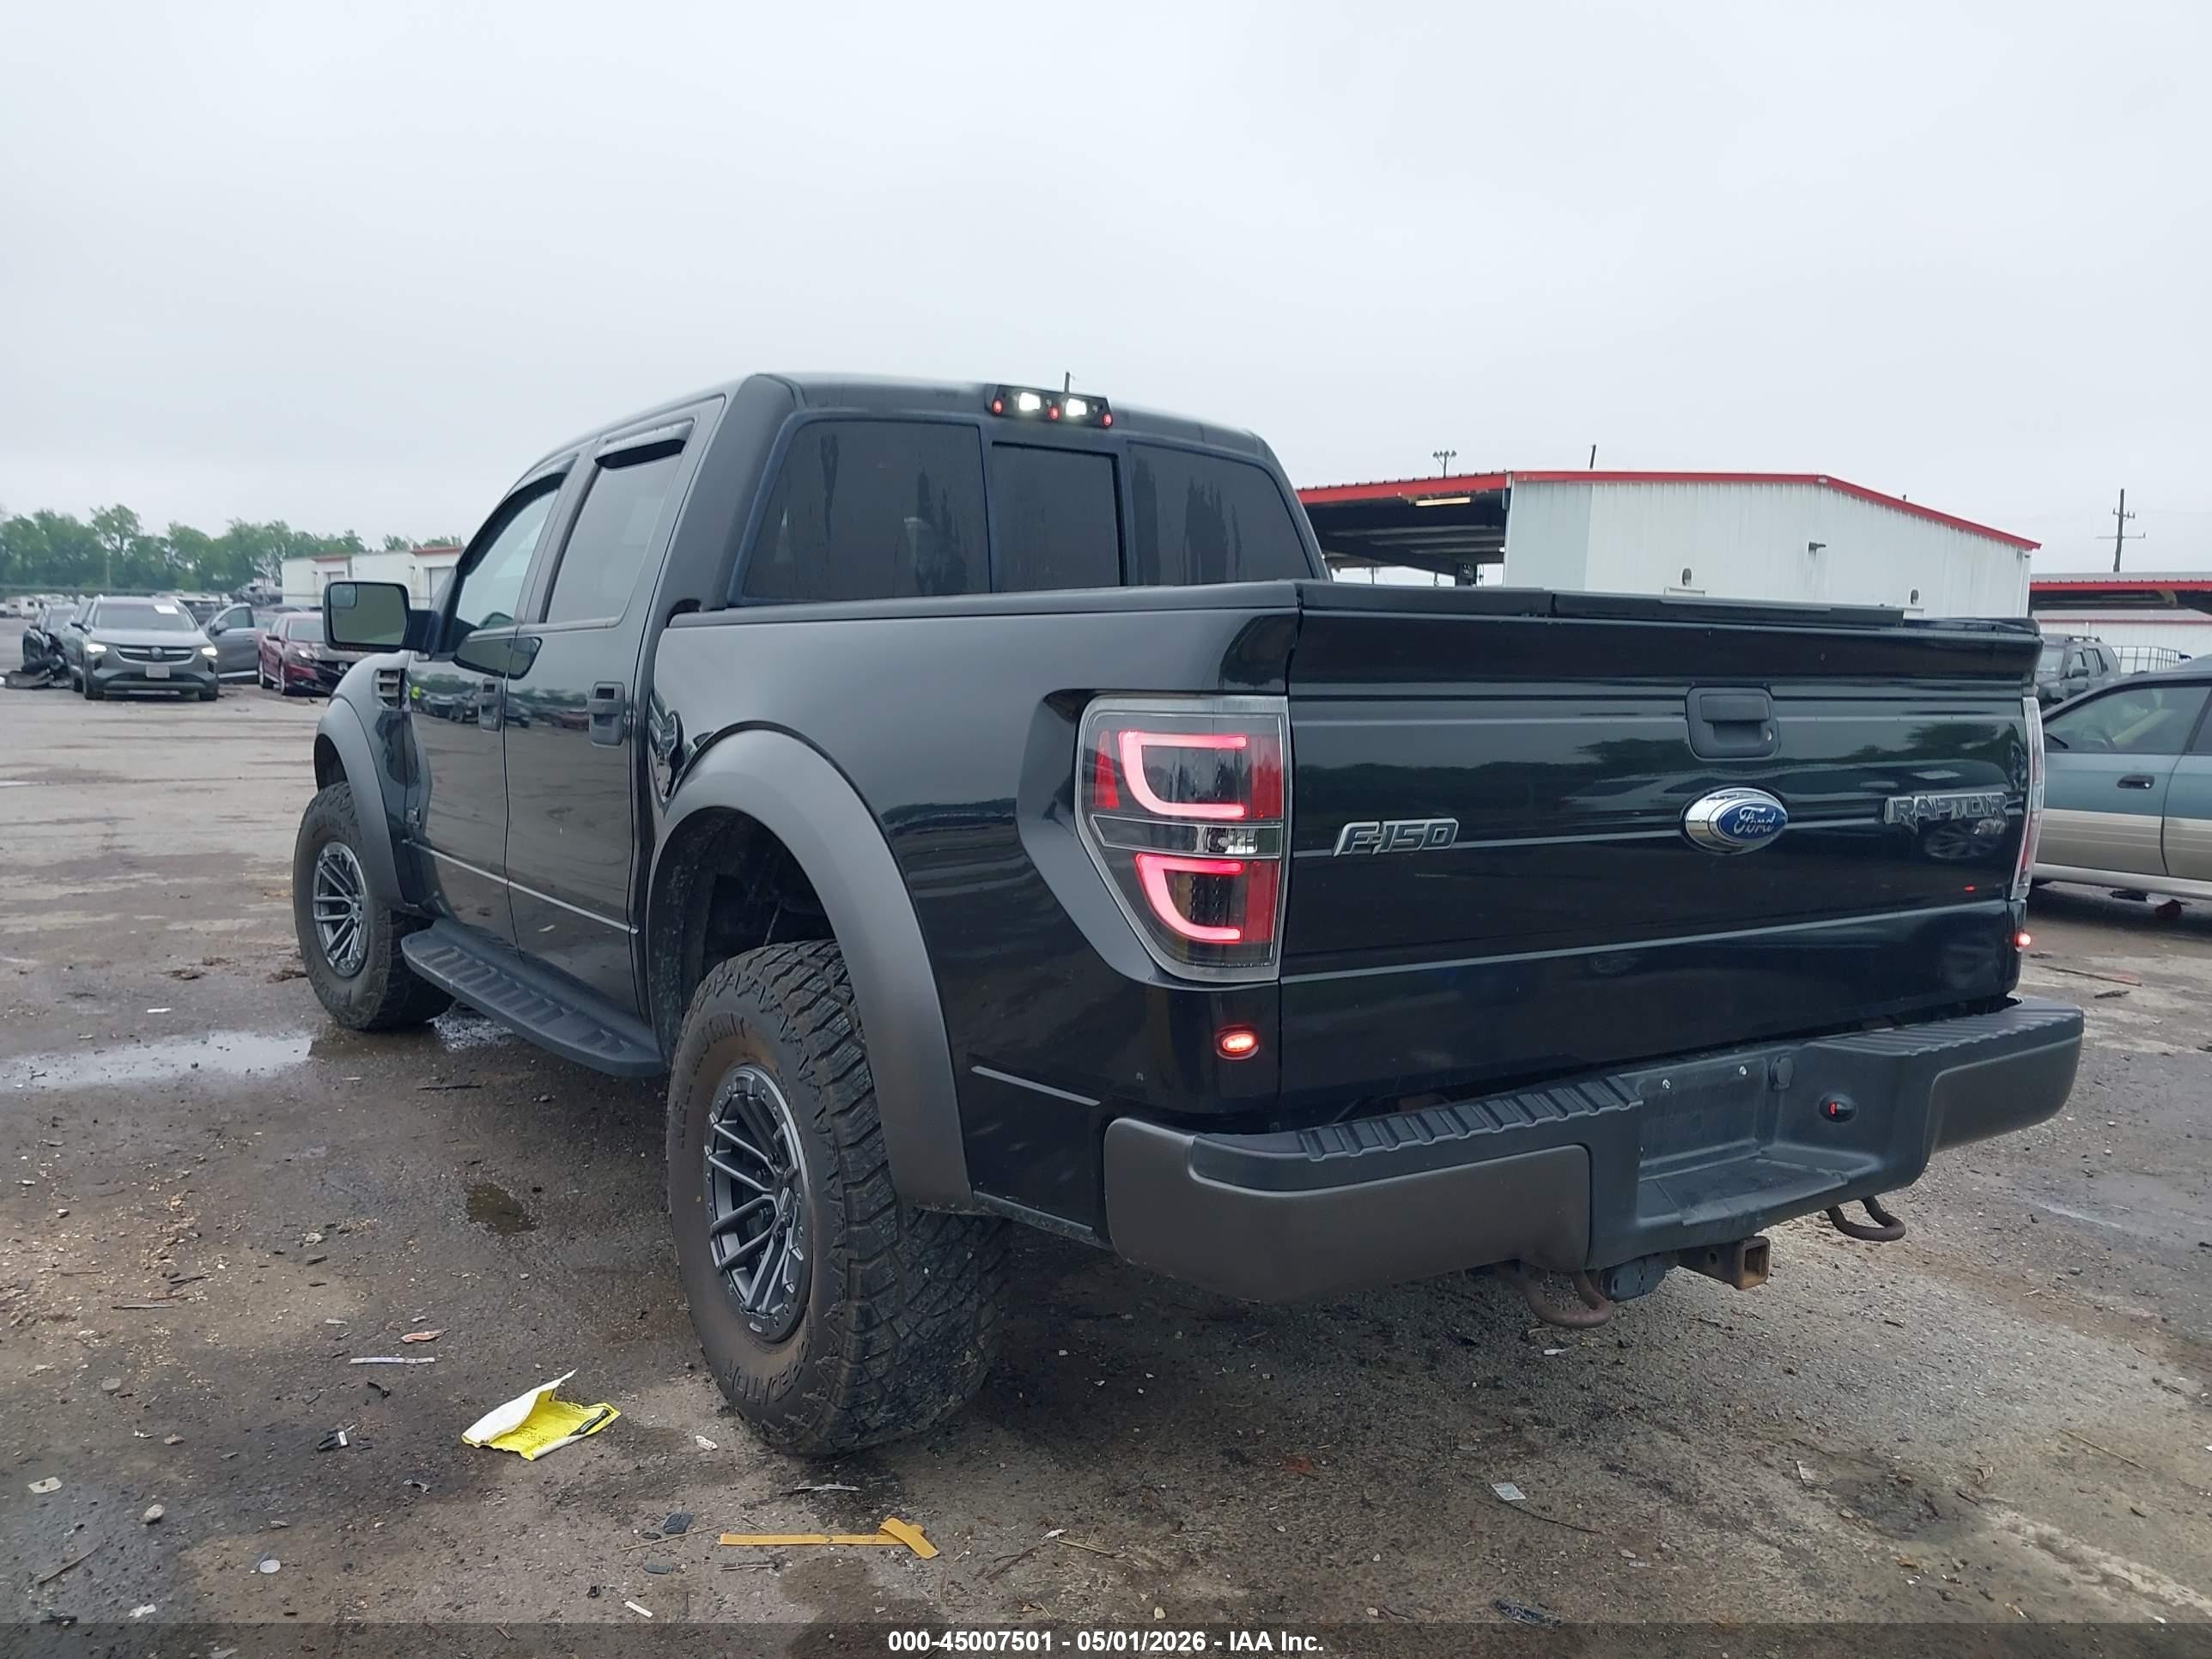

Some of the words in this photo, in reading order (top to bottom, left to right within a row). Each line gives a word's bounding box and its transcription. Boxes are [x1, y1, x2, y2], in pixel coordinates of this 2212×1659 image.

[1733, 805, 1777, 835] Ford
[1884, 792, 2008, 830] RAPTOR
[1333, 817, 1459, 858] F-150
